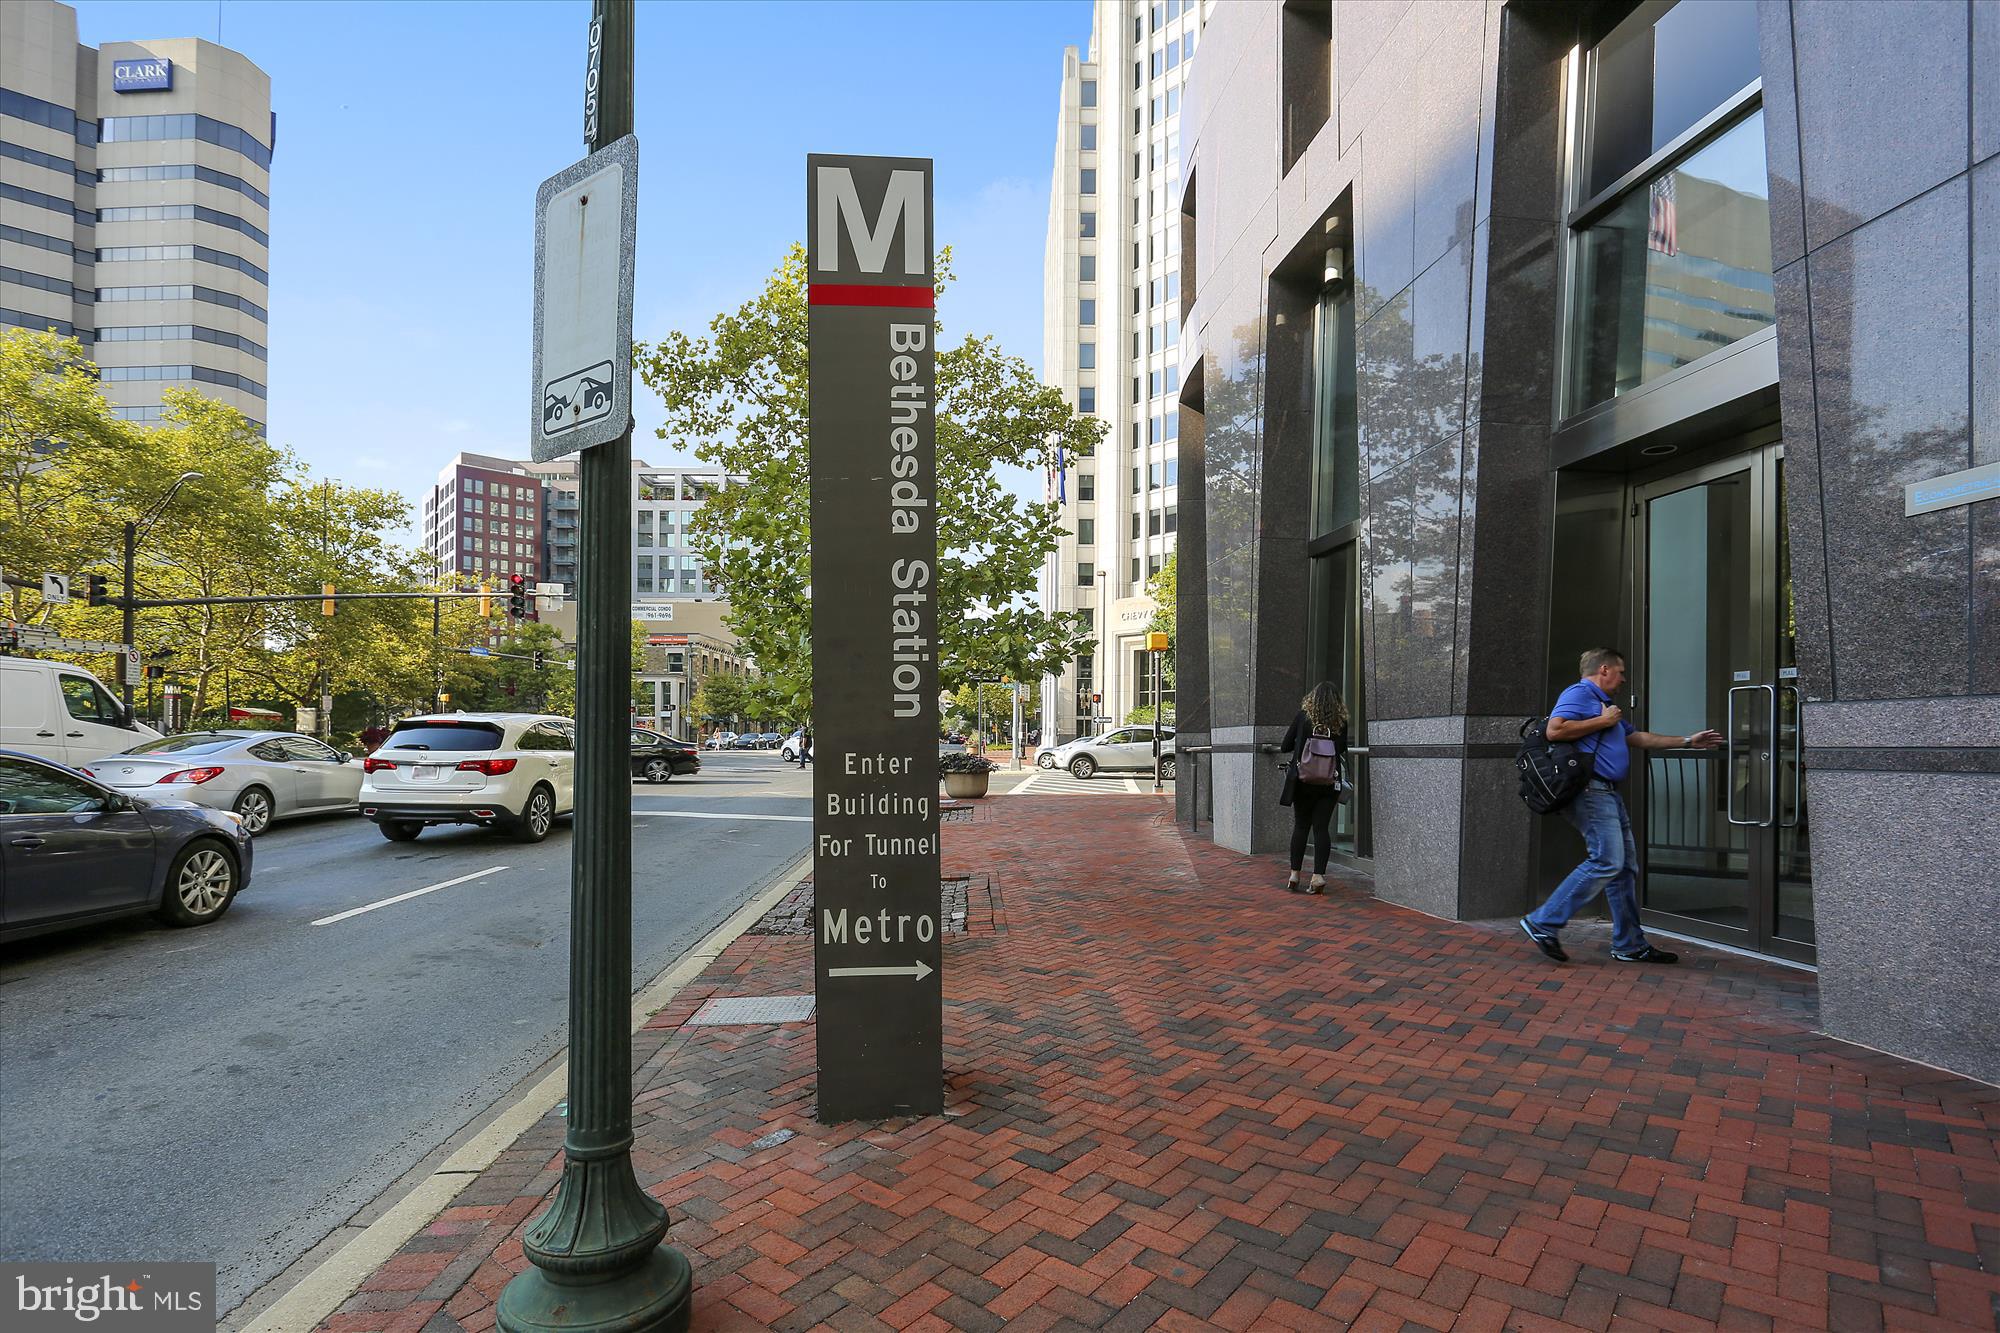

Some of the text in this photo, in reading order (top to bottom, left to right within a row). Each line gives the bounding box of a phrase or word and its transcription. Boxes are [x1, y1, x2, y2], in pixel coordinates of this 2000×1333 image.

[115, 64, 167, 79] CLARK
[585, 23, 600, 138] 07054
[817, 166, 925, 275] M
[889, 323, 930, 718] Bethesda Station
[47, 593, 66, 602] ONLY
[1121, 610, 1149, 621] CHEVY
[845, 752, 913, 775] Enter
[827, 792, 929, 821] Building
[819, 833, 936, 857] For Tunnel
[870, 873, 887, 889] To
[823, 907, 934, 945] Metro
